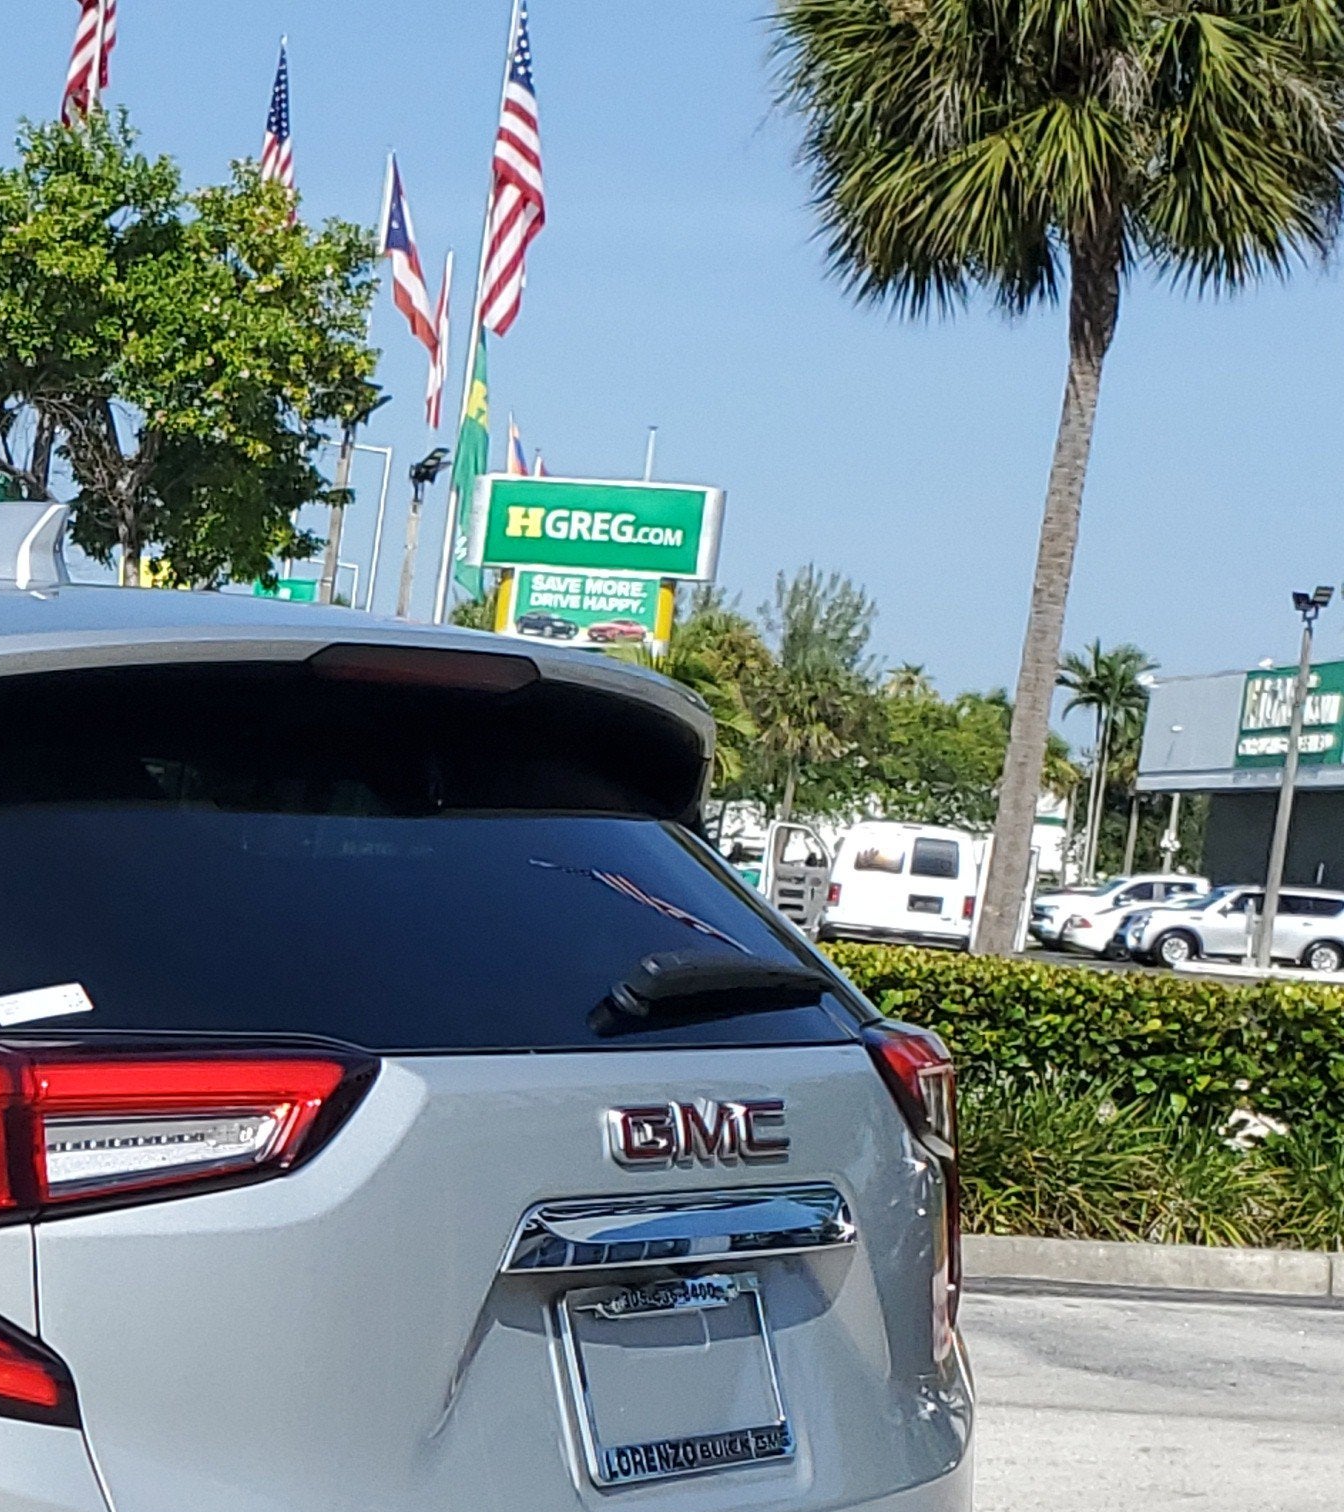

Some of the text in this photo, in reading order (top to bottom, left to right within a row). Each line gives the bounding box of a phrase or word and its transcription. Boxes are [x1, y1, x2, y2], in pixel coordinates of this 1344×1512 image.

[505, 505, 684, 548] HGREG.COM
[529, 592, 580, 609] DRIVE
[531, 574, 648, 599] SAVE MORE.
[606, 1098, 790, 1168] GMC
[605, 1441, 698, 1480] LORENZO
[699, 1437, 750, 1460] BUICK
